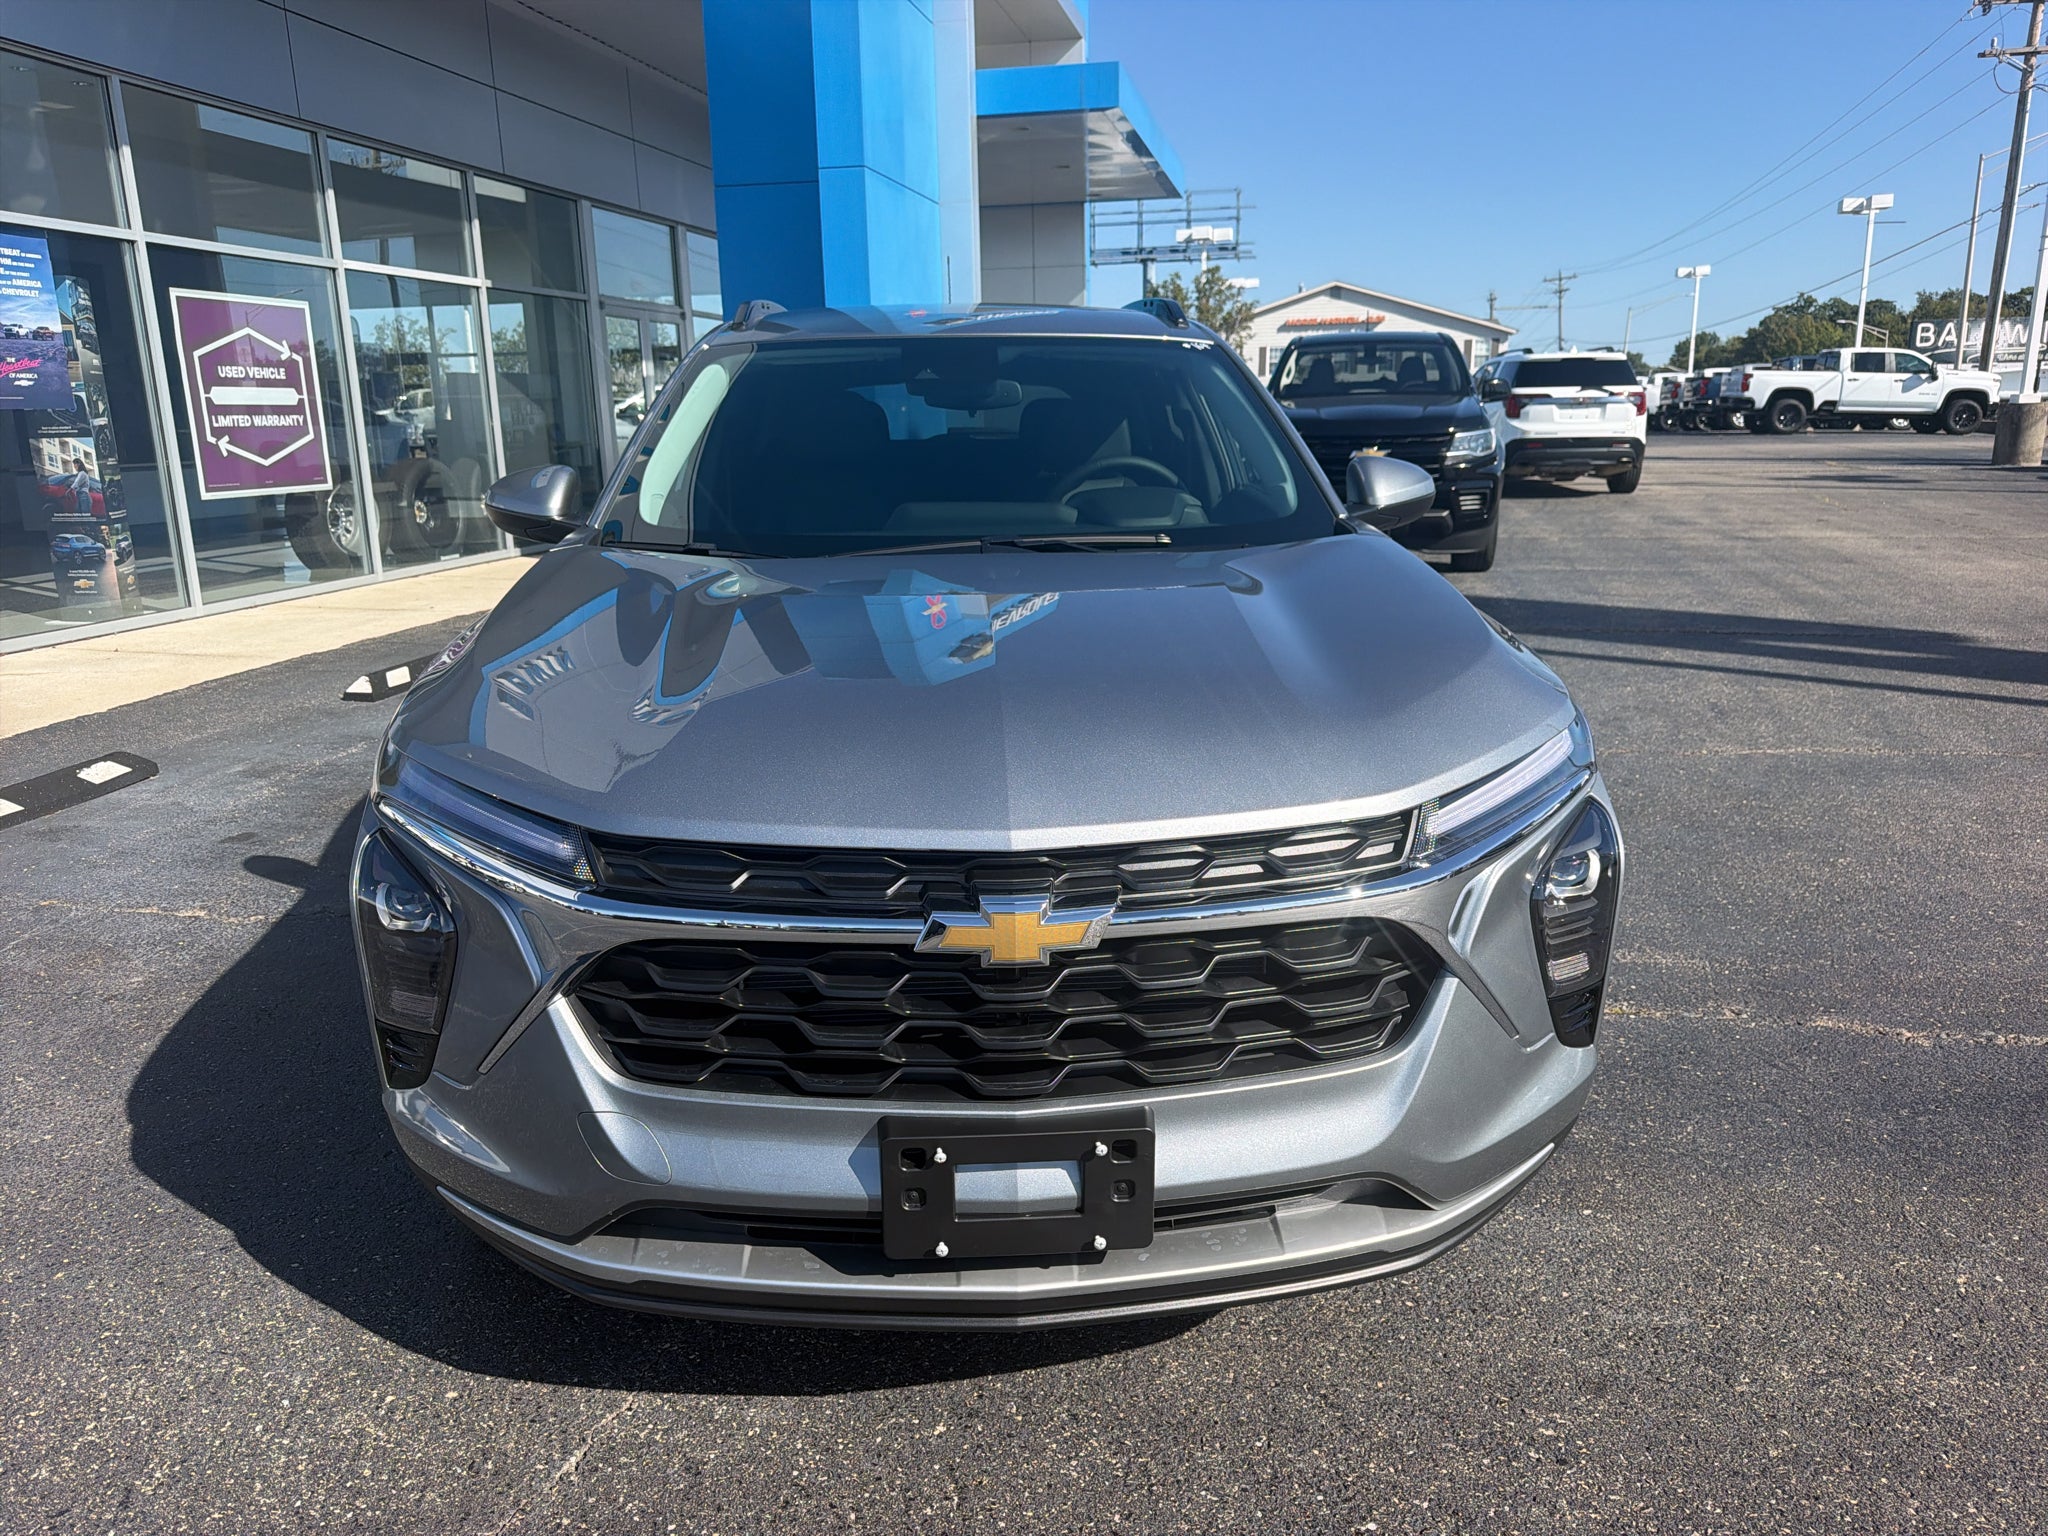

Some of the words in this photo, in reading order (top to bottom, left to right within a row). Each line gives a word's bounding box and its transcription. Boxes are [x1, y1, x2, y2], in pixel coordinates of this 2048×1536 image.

[12, 278, 42, 288] AMERICA
[2, 287, 39, 298] CHEVROLET
[217, 365, 245, 378] USED
[247, 366, 286, 380] VEHICLE
[211, 414, 251, 427] LIMITED
[252, 414, 304, 427] WARRANTY
